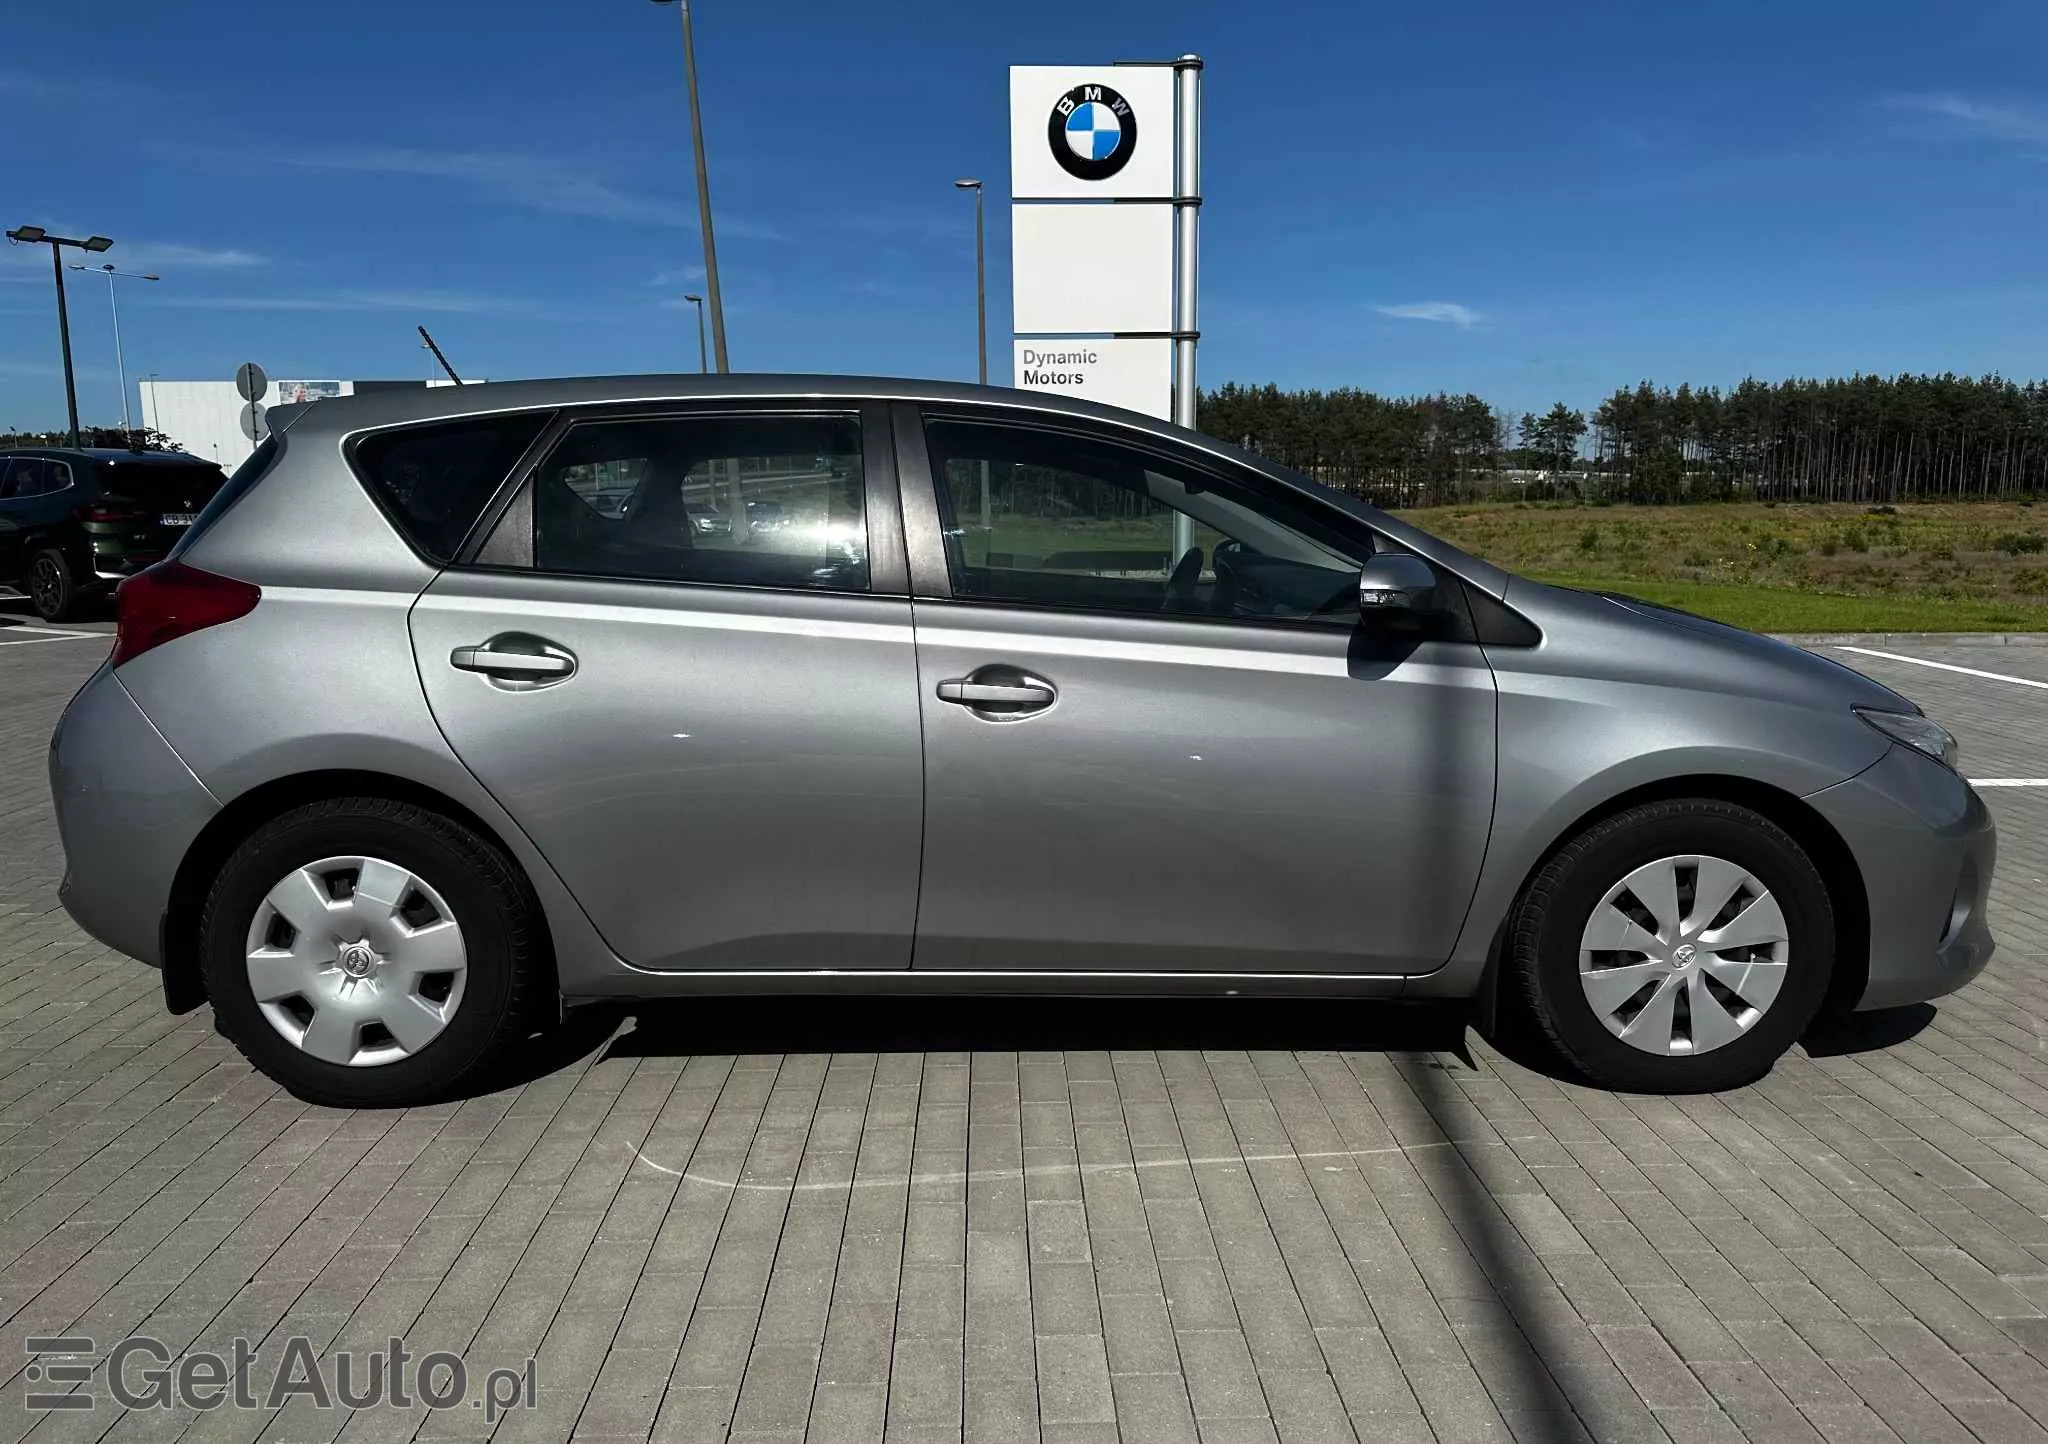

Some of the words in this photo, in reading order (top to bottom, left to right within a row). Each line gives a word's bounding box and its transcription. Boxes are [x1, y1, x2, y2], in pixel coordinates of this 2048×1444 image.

[1057, 86, 1130, 117] BMW
[1023, 349, 1097, 368] Dynamic
[1023, 370, 1084, 385] Motors
